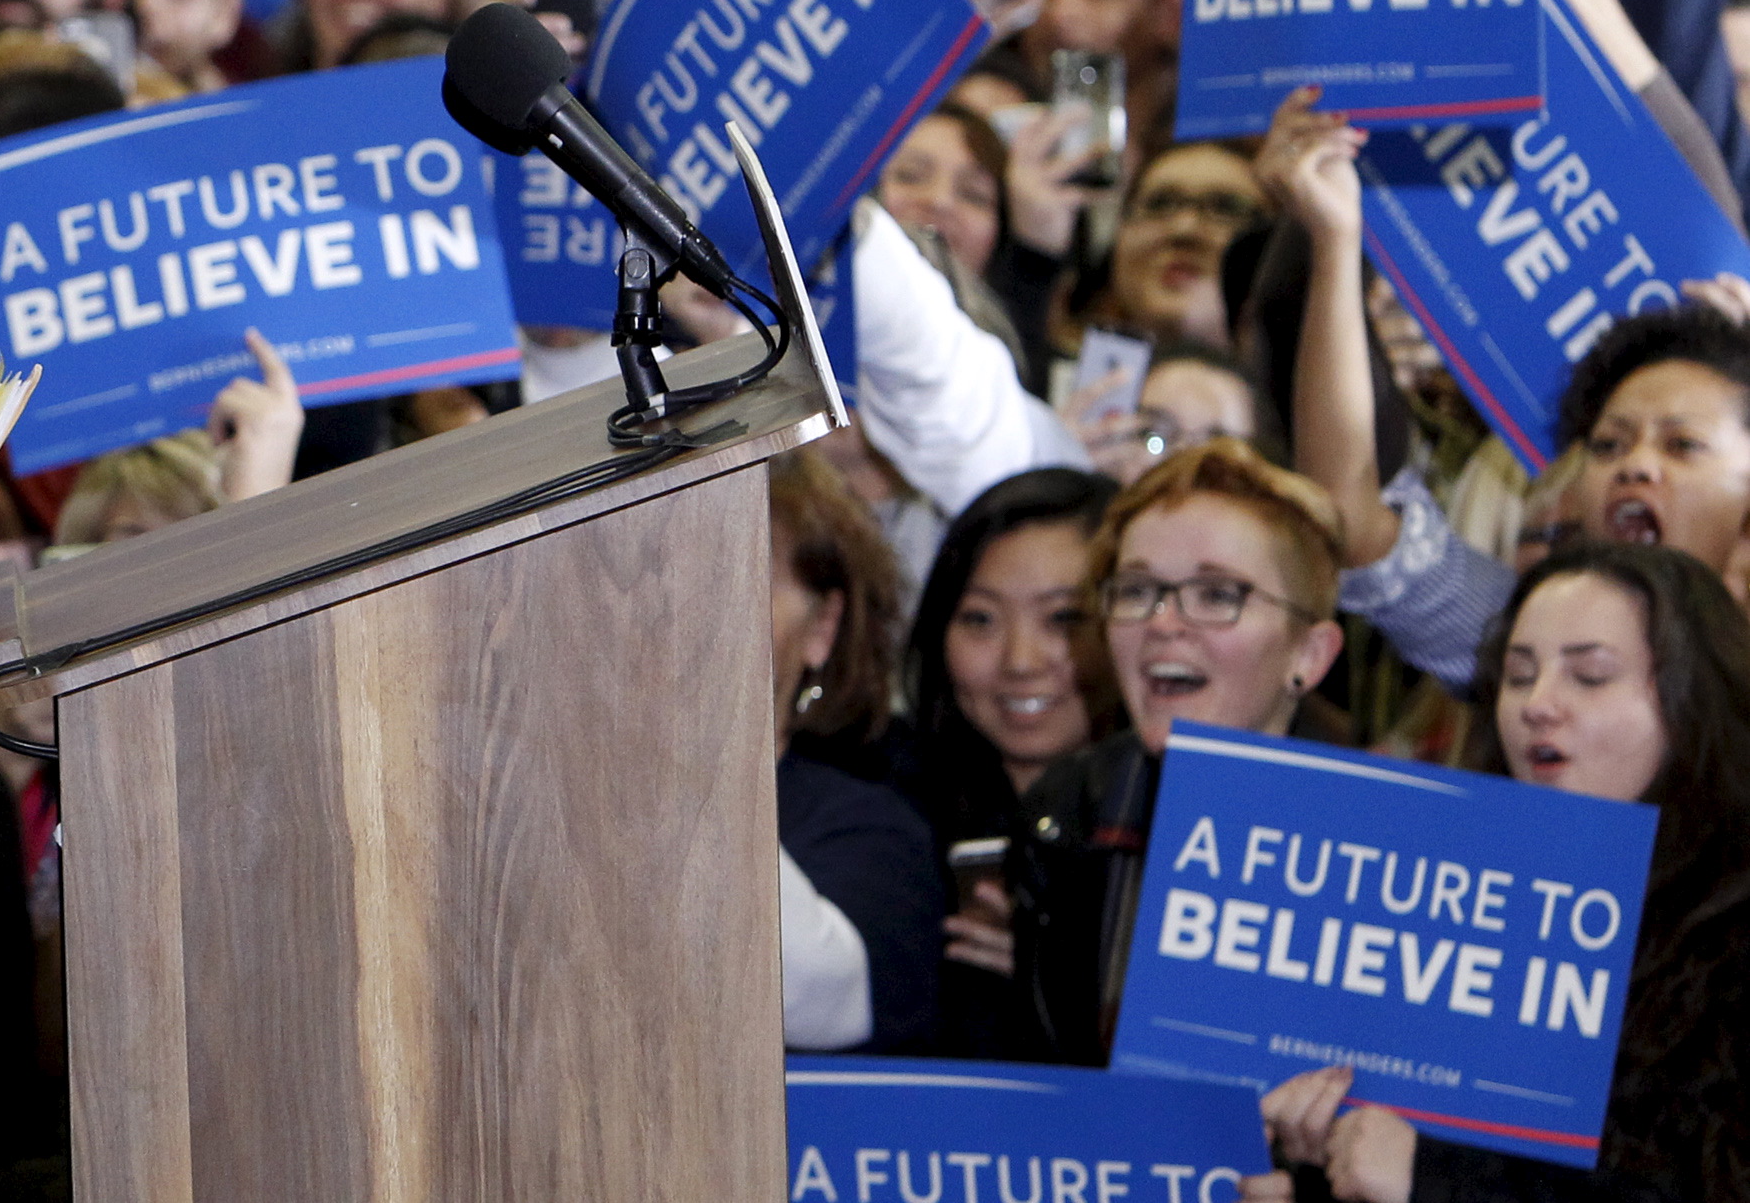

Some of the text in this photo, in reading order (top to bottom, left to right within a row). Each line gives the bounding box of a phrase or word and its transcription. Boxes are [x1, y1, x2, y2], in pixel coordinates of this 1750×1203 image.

[57, 154, 347, 266] FUTURE
[353, 137, 464, 203] TO
[1510, 116, 1620, 251] URE
[2, 218, 364, 360] BELIEVE
[376, 202, 484, 281] IN
[1172, 815, 1623, 952] A FUTURE TO
[1156, 887, 1612, 1040] BELIEVE IN
[791, 1145, 839, 1203] A
[854, 1147, 1132, 1203] FUTURE
